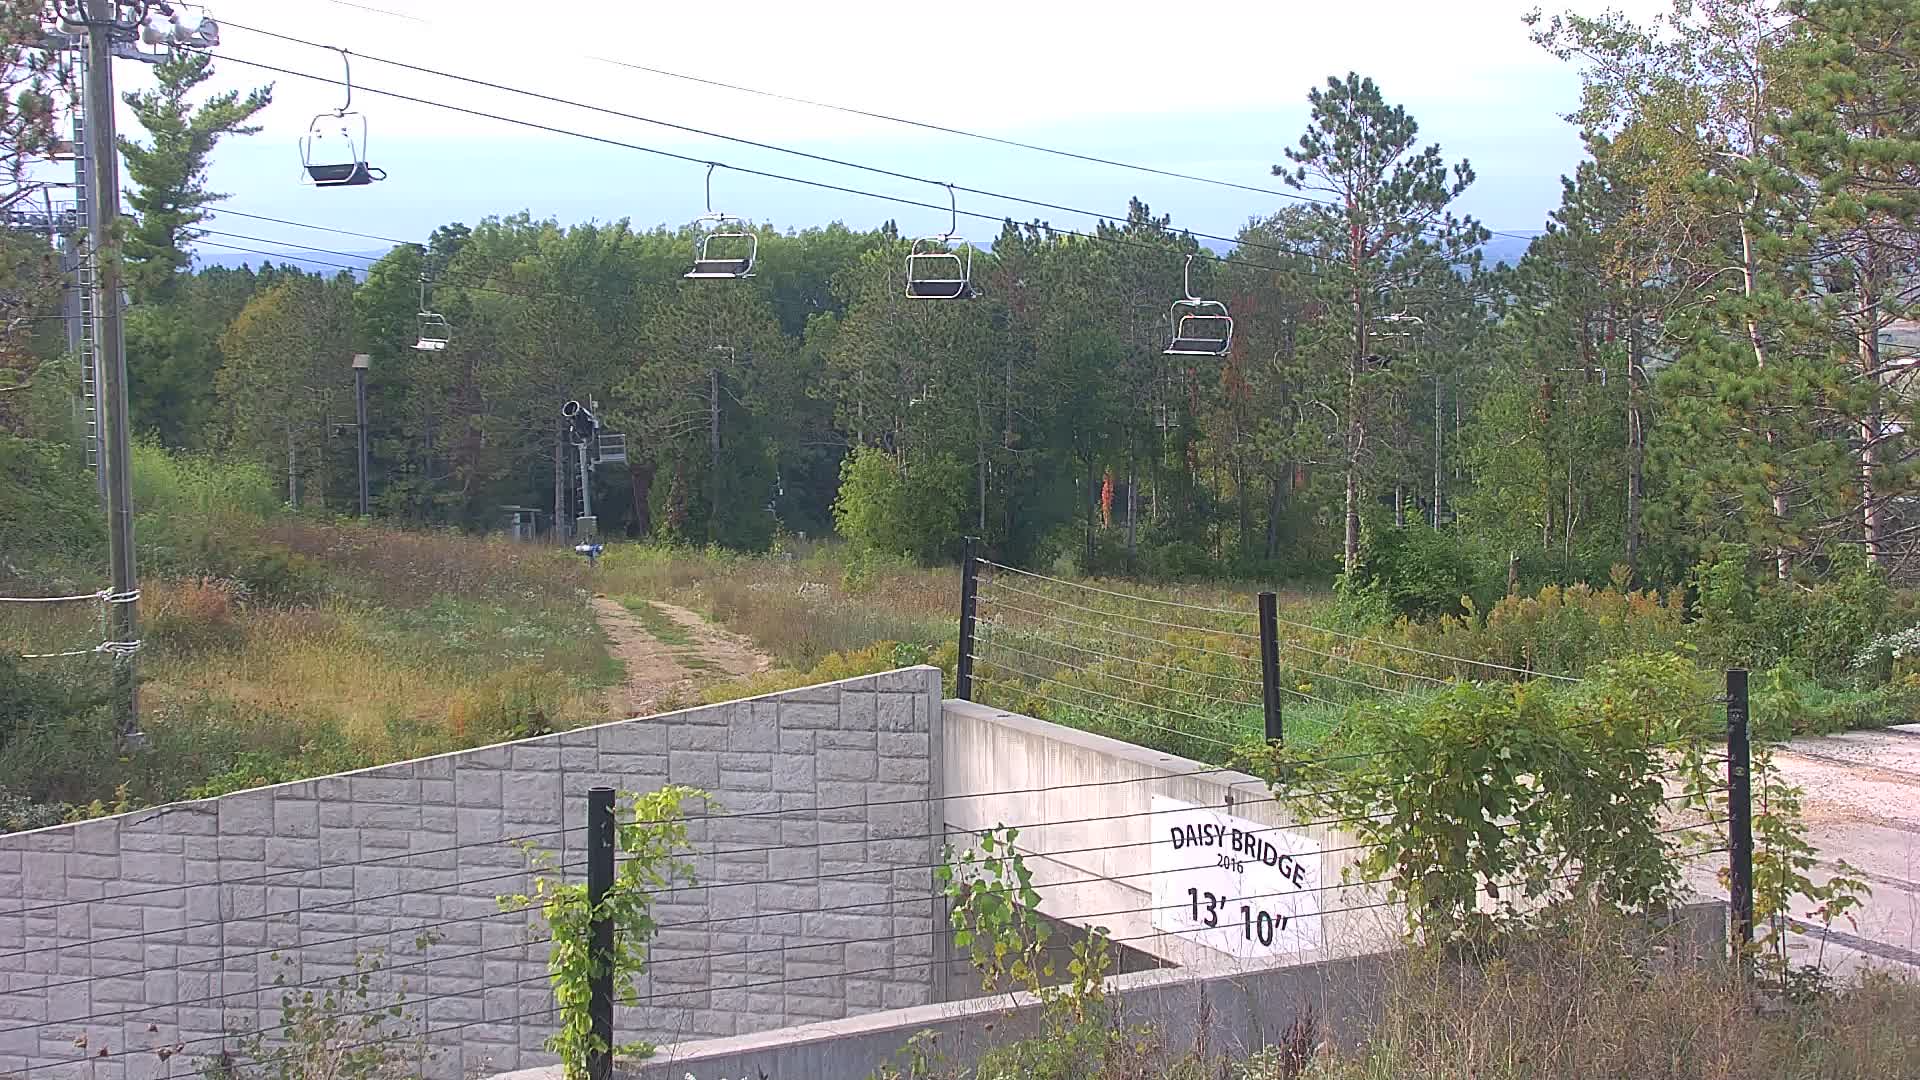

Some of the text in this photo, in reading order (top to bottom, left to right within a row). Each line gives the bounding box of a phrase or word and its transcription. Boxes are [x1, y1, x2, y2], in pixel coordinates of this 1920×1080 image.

[1171, 823, 1306, 889] DAISY BRIDGE
[1217, 853, 1244, 874] 2016
[1188, 887, 1226, 929] 13'
